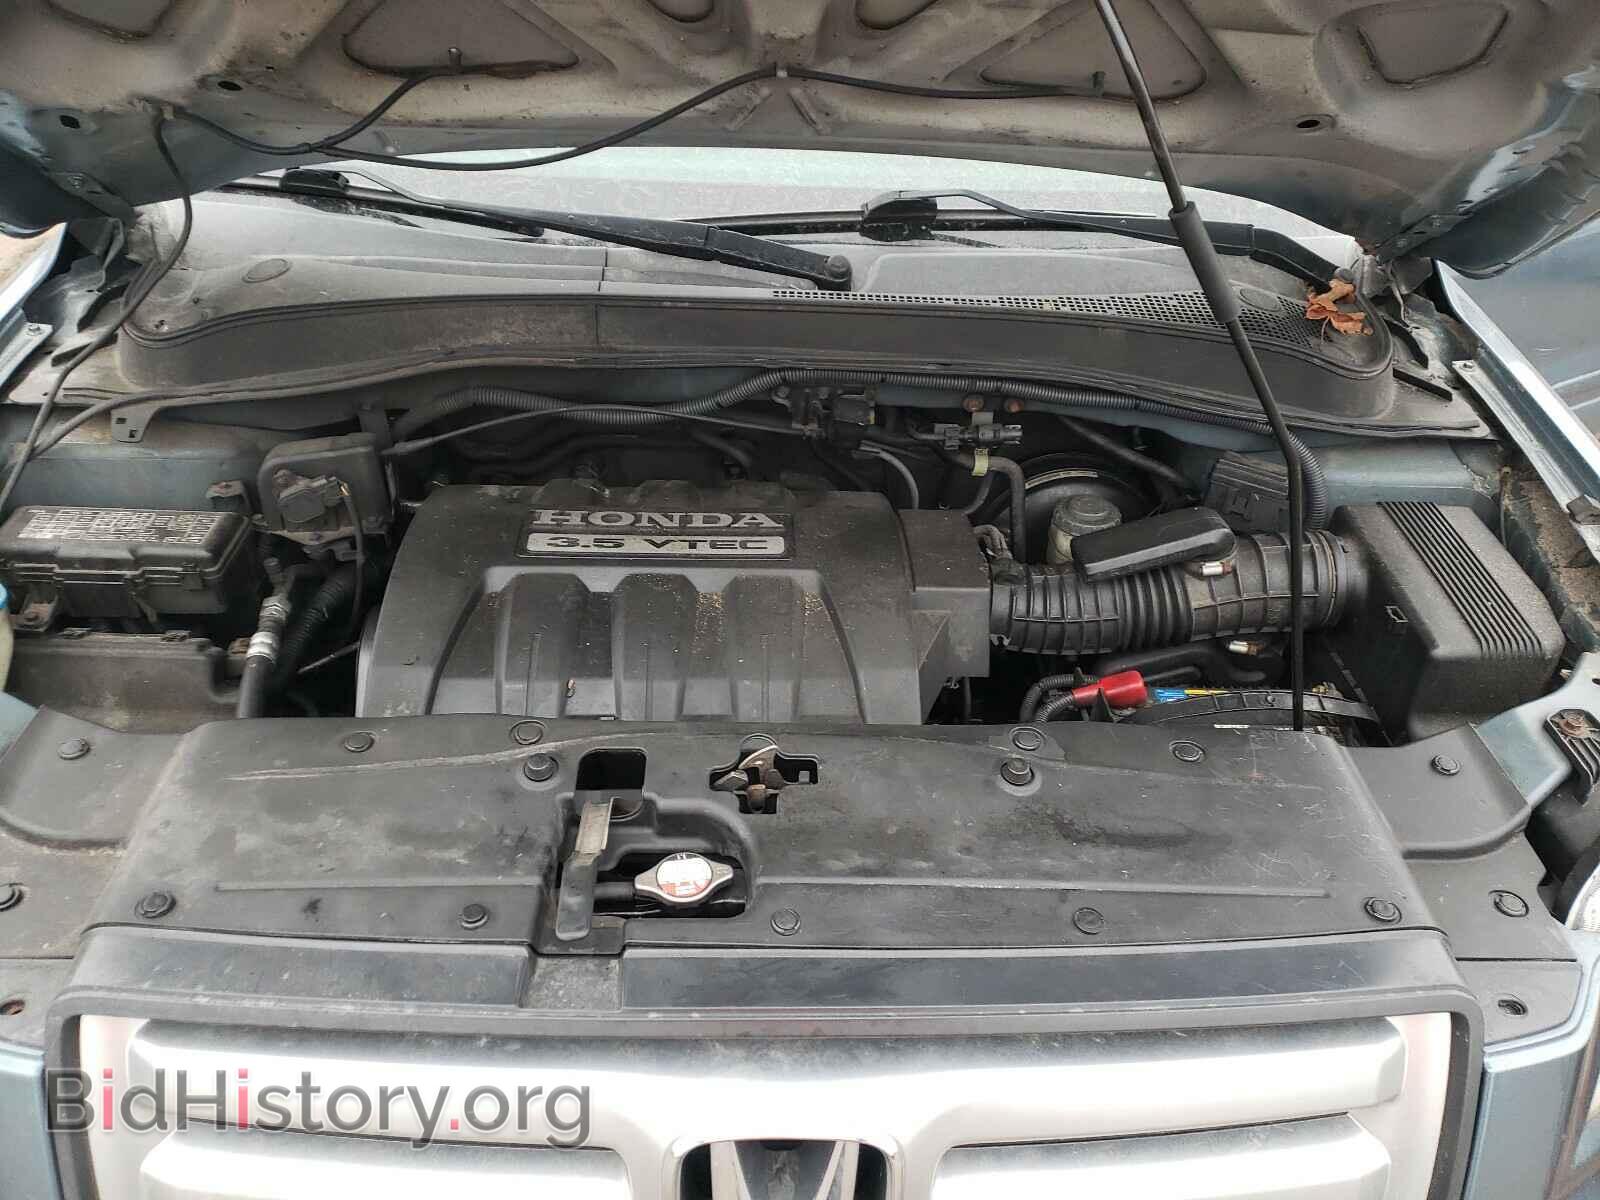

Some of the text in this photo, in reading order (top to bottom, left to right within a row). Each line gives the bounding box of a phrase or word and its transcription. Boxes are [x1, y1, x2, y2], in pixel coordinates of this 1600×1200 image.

[532, 509, 784, 528] HONDA
[546, 536, 769, 551] 3.5 VTEC
